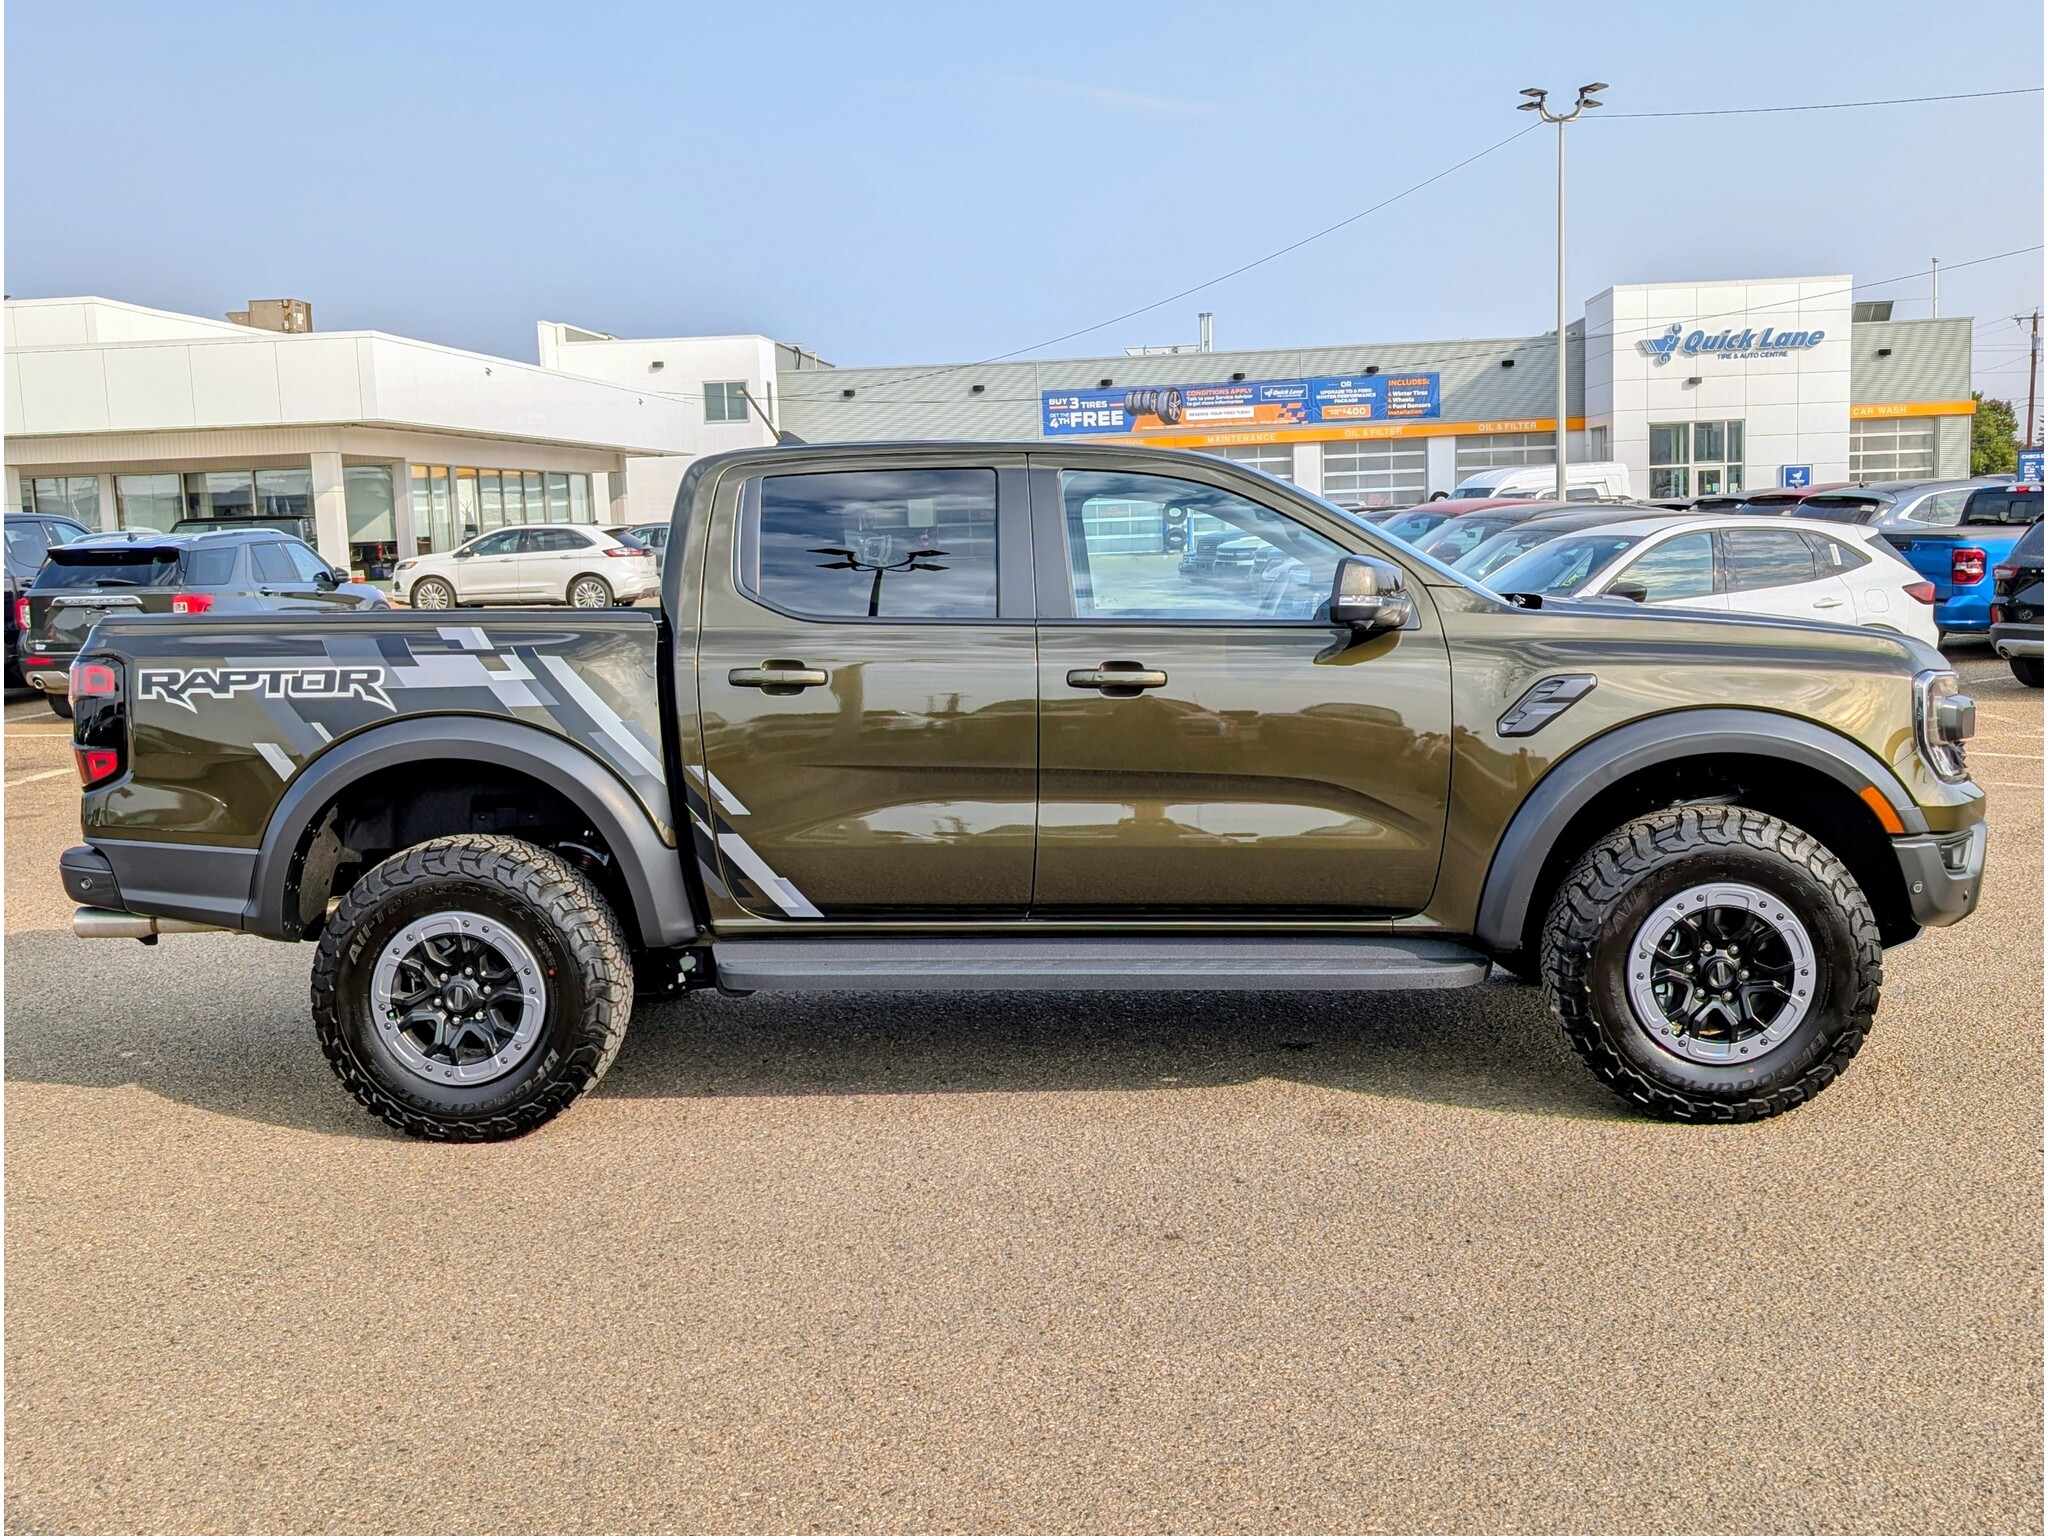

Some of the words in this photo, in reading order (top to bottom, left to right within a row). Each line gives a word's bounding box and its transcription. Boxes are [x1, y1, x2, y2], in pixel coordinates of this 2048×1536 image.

[1683, 328, 1757, 355] Quick
[1757, 327, 1826, 348] Lane
[1739, 351, 1759, 359] AUTO
[1760, 350, 1788, 358] CENTRE
[1388, 378, 1430, 387] INCLUDES:
[1186, 388, 1230, 397] CONDITIONS
[1230, 387, 1253, 395] APPLY
[1272, 389, 1289, 397] Quick
[1289, 388, 1304, 396] Lane
[1069, 397, 1079, 409] 3
[1080, 400, 1107, 409] TIRES
[1342, 407, 1366, 416] $400
[1853, 408, 1874, 416] CAR
[1878, 406, 1907, 415] WASH
[1049, 418, 1070, 429] 4TH
[1070, 410, 1124, 428] FREE
[1479, 423, 1494, 431] OIL
[1496, 423, 1503, 431] &
[1505, 421, 1537, 430] FILTER
[1344, 429, 1360, 437] OIL
[1370, 427, 1402, 436] FILTER
[1207, 434, 1276, 444] MAINTENANCE
[138, 666, 398, 714] RAPTOR
